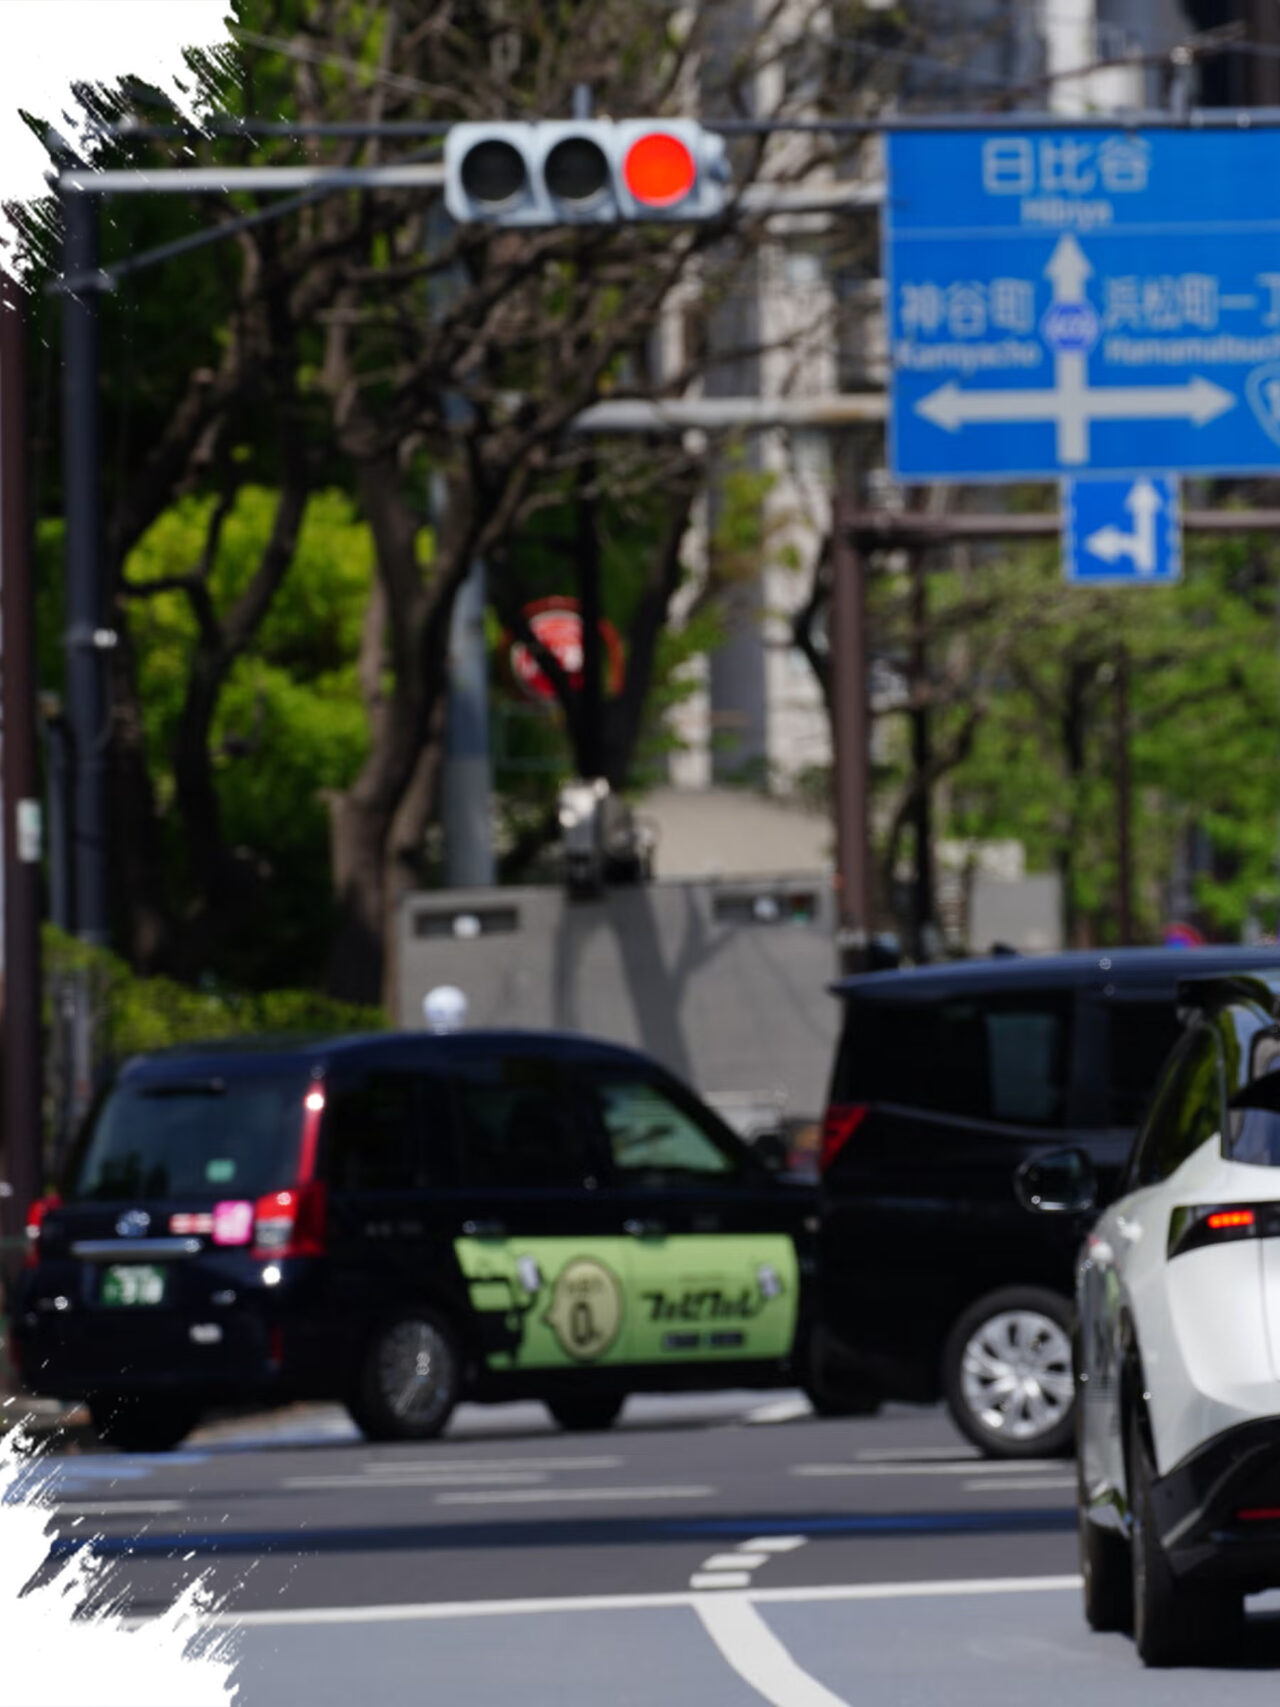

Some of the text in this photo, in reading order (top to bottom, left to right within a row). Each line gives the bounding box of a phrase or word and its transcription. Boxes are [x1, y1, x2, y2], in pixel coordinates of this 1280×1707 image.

[983, 135, 1153, 194] 日比谷
[1021, 198, 1113, 231] Hibiya
[902, 279, 1034, 337] 神谷町
